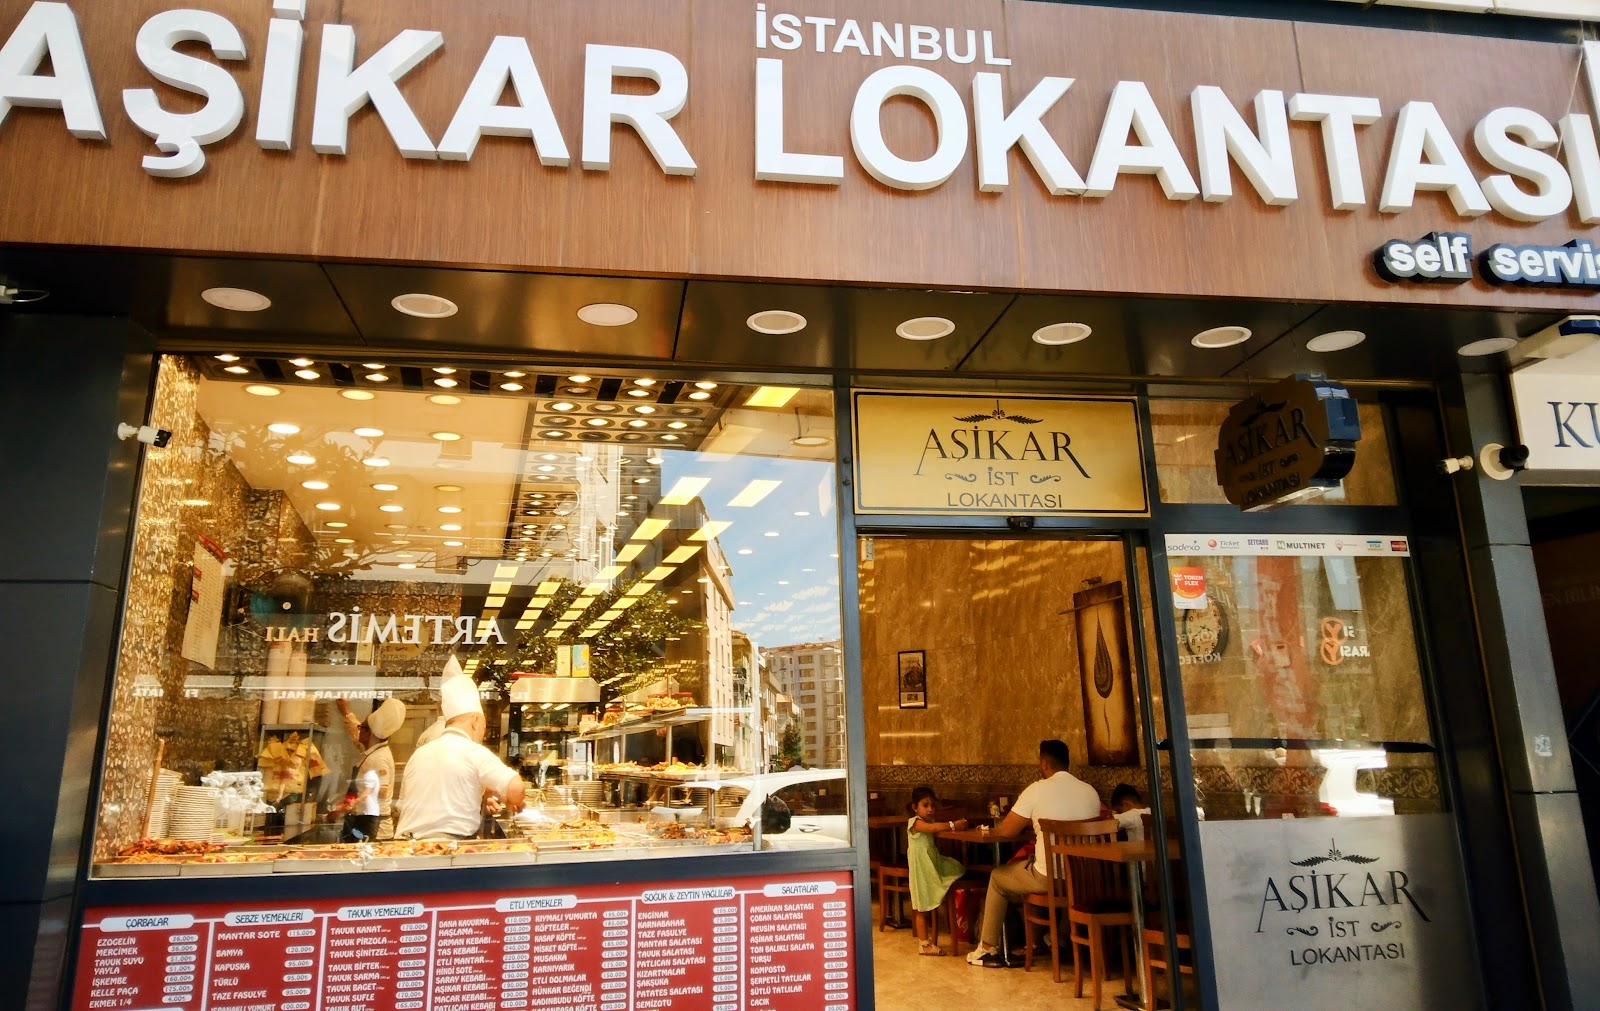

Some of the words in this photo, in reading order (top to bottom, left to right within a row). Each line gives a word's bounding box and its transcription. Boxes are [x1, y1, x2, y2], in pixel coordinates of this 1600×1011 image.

[755, 3, 1012, 66] İSTANBUL
[0, 0, 697, 178] AŞİKAR
[755, 57, 1600, 225] LOKANTASI
[1390, 236, 1469, 273] self
[1496, 243, 1600, 279] servi
[913, 425, 1092, 479] AŞİKAR
[988, 466, 1016, 487] İST
[947, 493, 1063, 509] LOKANTASI
[1168, 541, 1200, 551] sodexo
[1286, 542, 1326, 550] MULTINET
[781, 885, 819, 895] SALATALAR
[526, 898, 563, 908] YEMEKLER
[1254, 869, 1431, 933] AŞİKAR
[374, 906, 415, 917] YEMEKLERİ
[750, 905, 783, 914] AMERİKAN
[784, 903, 814, 911] SALATASI
[235, 914, 259, 924] SEBZE
[261, 912, 304, 922] YEMEKLERİ
[535, 914, 563, 923] KIYMALI
[564, 912, 598, 920] YUMURTA
[638, 911, 669, 920] ENGİNAR
[750, 914, 772, 923] ÇOBAN
[773, 912, 803, 920] SALATASI
[126, 917, 169, 929] ÇORBALAR
[438, 920, 457, 928] DANA
[458, 918, 489, 927] KAVURMA
[535, 923, 570, 932] KÖFTELER
[637, 920, 685, 929] KARNABAHAR
[776, 923, 807, 931] SALATASI
[1329, 916, 1359, 938] İST
[330, 927, 355, 935] TAVUK
[356, 925, 382, 934] KANAT
[438, 928, 473, 937] HAŞLAMA
[637, 930, 655, 938] TAZE
[657, 928, 687, 937] FASULYE
[217, 932, 255, 941] MANTAR
[257, 930, 280, 938] SOTE
[534, 934, 555, 943] KASAP
[556, 933, 576, 941] KÖFTE
[774, 933, 805, 942] SALATASI
[97, 936, 136, 947] EZOGELİN
[330, 939, 355, 947] TAVUK
[356, 937, 387, 946] PİRZOLA
[437, 938, 464, 947] ORMAN
[465, 937, 491, 945] KEBABI
[637, 940, 668, 948] MANTAR
[668, 937, 702, 946] SALATASI
[96, 946, 138, 957] MERCİMEK
[437, 948, 451, 956] TAS
[452, 947, 478, 955] KEBABI
[557, 943, 577, 951] KÖFTE
[750, 946, 764, 954] TON
[790, 943, 815, 951] SALATA
[216, 949, 243, 958] BAMYA
[329, 951, 354, 959] TAVUK
[637, 950, 661, 958] TAVUK
[661, 948, 695, 956] SALATASI
[1290, 943, 1405, 966] LOKANTASI
[94, 959, 121, 967] TAVUK
[123, 957, 144, 965] SUYU
[453, 956, 485, 965] MANTAR
[533, 954, 567, 963] MUSAKKA
[637, 959, 671, 968] PATLICAN
[672, 957, 706, 965] SALATASI
[750, 955, 772, 964] TURŞU
[94, 967, 120, 975] YAYLA
[214, 963, 250, 971] KAPUSKA
[328, 964, 353, 972] TAVUK
[354, 961, 380, 970] BİFTEK
[455, 966, 473, 974] SOTE
[533, 963, 575, 973] KARNIYARIK
[750, 965, 786, 974] KOMPOSTO
[327, 974, 352, 982] TAVUK
[353, 972, 380, 981] SARMA
[636, 968, 686, 978] KIZARTMALAR
[781, 974, 812, 982] TATLILAR
[92, 977, 127, 988] İŞKEMBE
[213, 977, 239, 987] TÜRLÜ
[435, 976, 460, 984] SARAY
[460, 974, 486, 982] KEBABI
[549, 974, 587, 984] DOLMALAR
[636, 978, 669, 988] ŞAKŞUKA
[326, 984, 351, 993] TAVUK
[352, 982, 377, 991] BAGET
[462, 983, 488, 991] KEBABI
[636, 988, 668, 998] PATATES
[669, 986, 703, 996] SALATASI
[750, 987, 771, 996] SÜTLÜ
[772, 985, 803, 994] TATLILAR
[90, 989, 115, 998] KELLE
[117, 987, 138, 996] PAÇA
[212, 992, 231, 1000] TAZE
[233, 990, 267, 999] FASULYE
[89, 1000, 117, 1008] EKMEK
[119, 998, 132, 1006] 1/4
[326, 995, 350, 1004] TAVUK
[351, 993, 375, 1002] SUFLE
[434, 995, 460, 1004] MACAR
[461, 993, 487, 1002] KEBABI
[531, 996, 572, 1006] KADINBUDU
[470, 1002, 496, 1010] KEBABI
[635, 999, 672, 1009] SEMİZOTU
